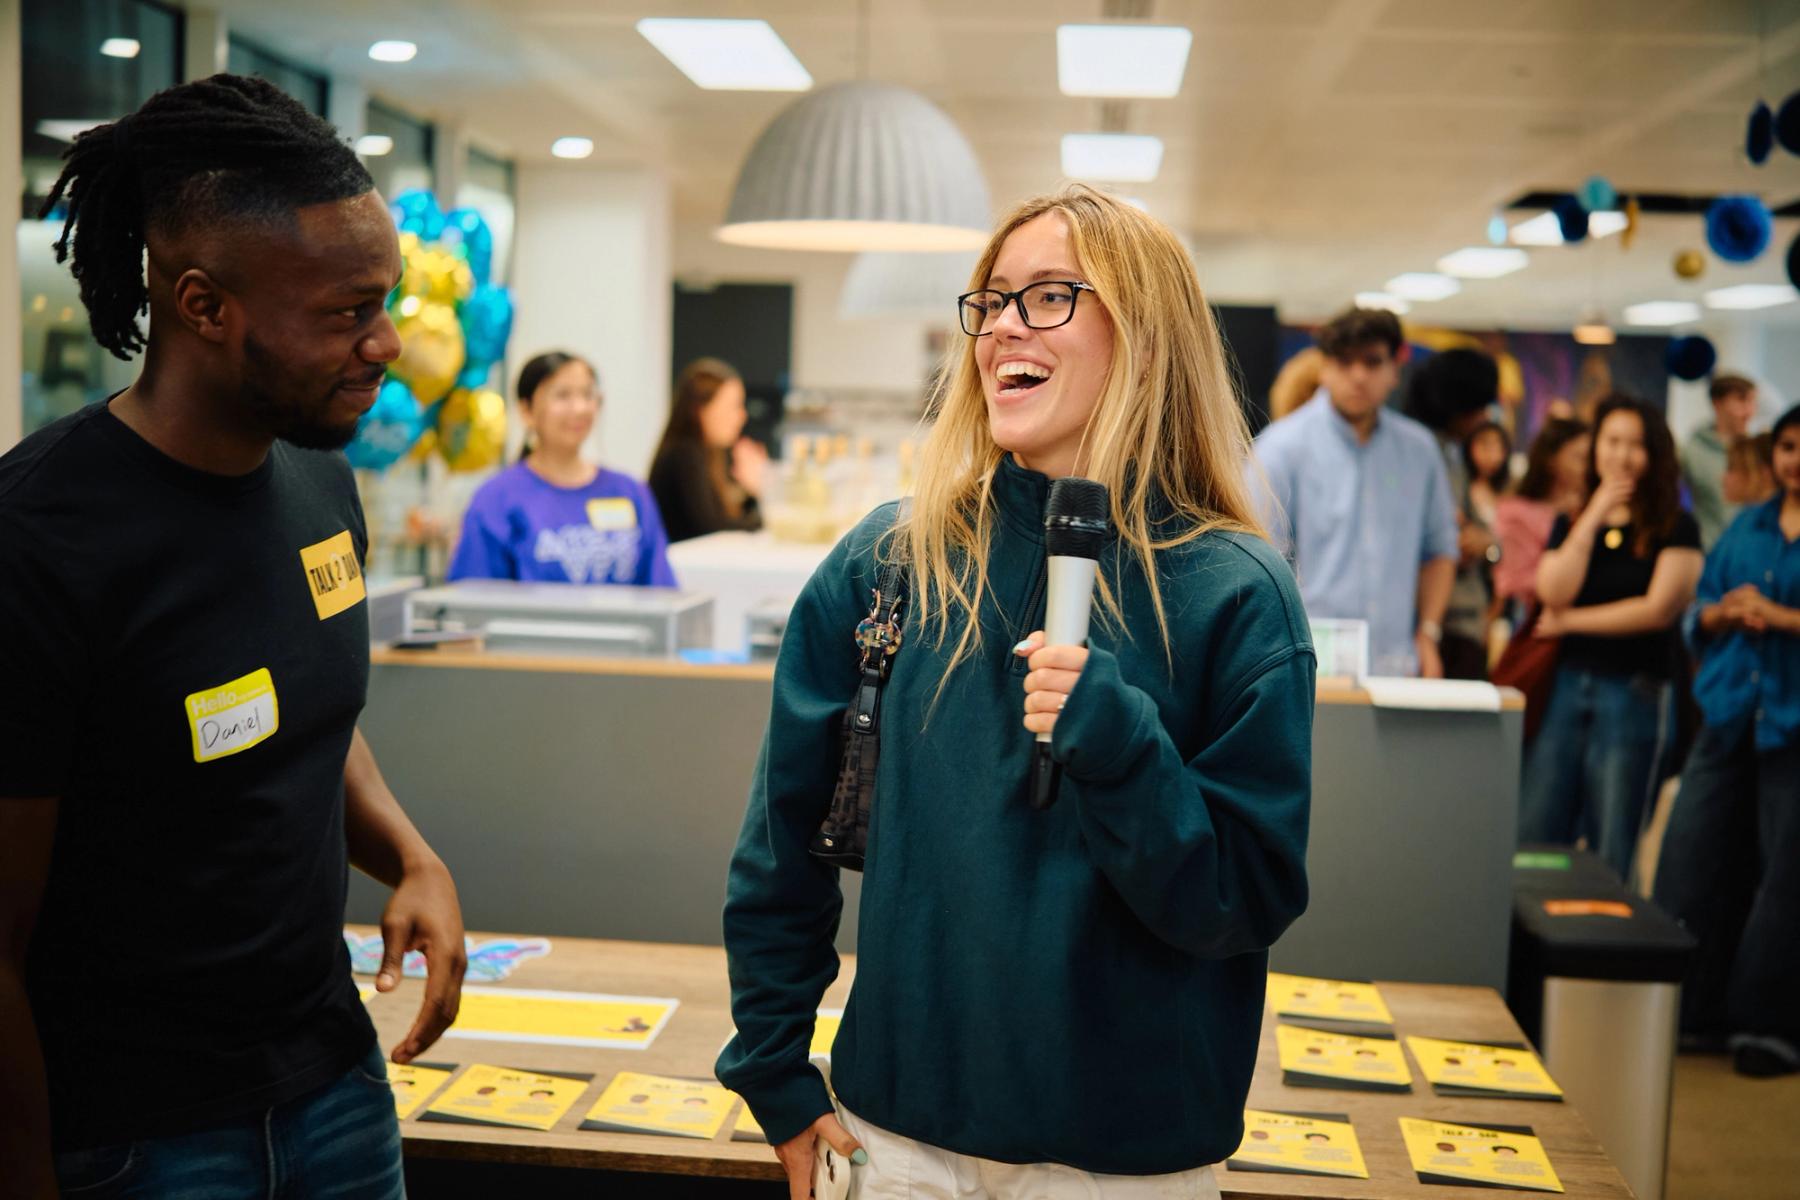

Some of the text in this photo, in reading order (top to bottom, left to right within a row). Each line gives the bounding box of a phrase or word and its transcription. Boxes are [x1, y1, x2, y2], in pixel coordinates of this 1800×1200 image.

[309, 562, 339, 596] TALK
[191, 691, 237, 716] Hello
[201, 705, 262, 749] Daniel
